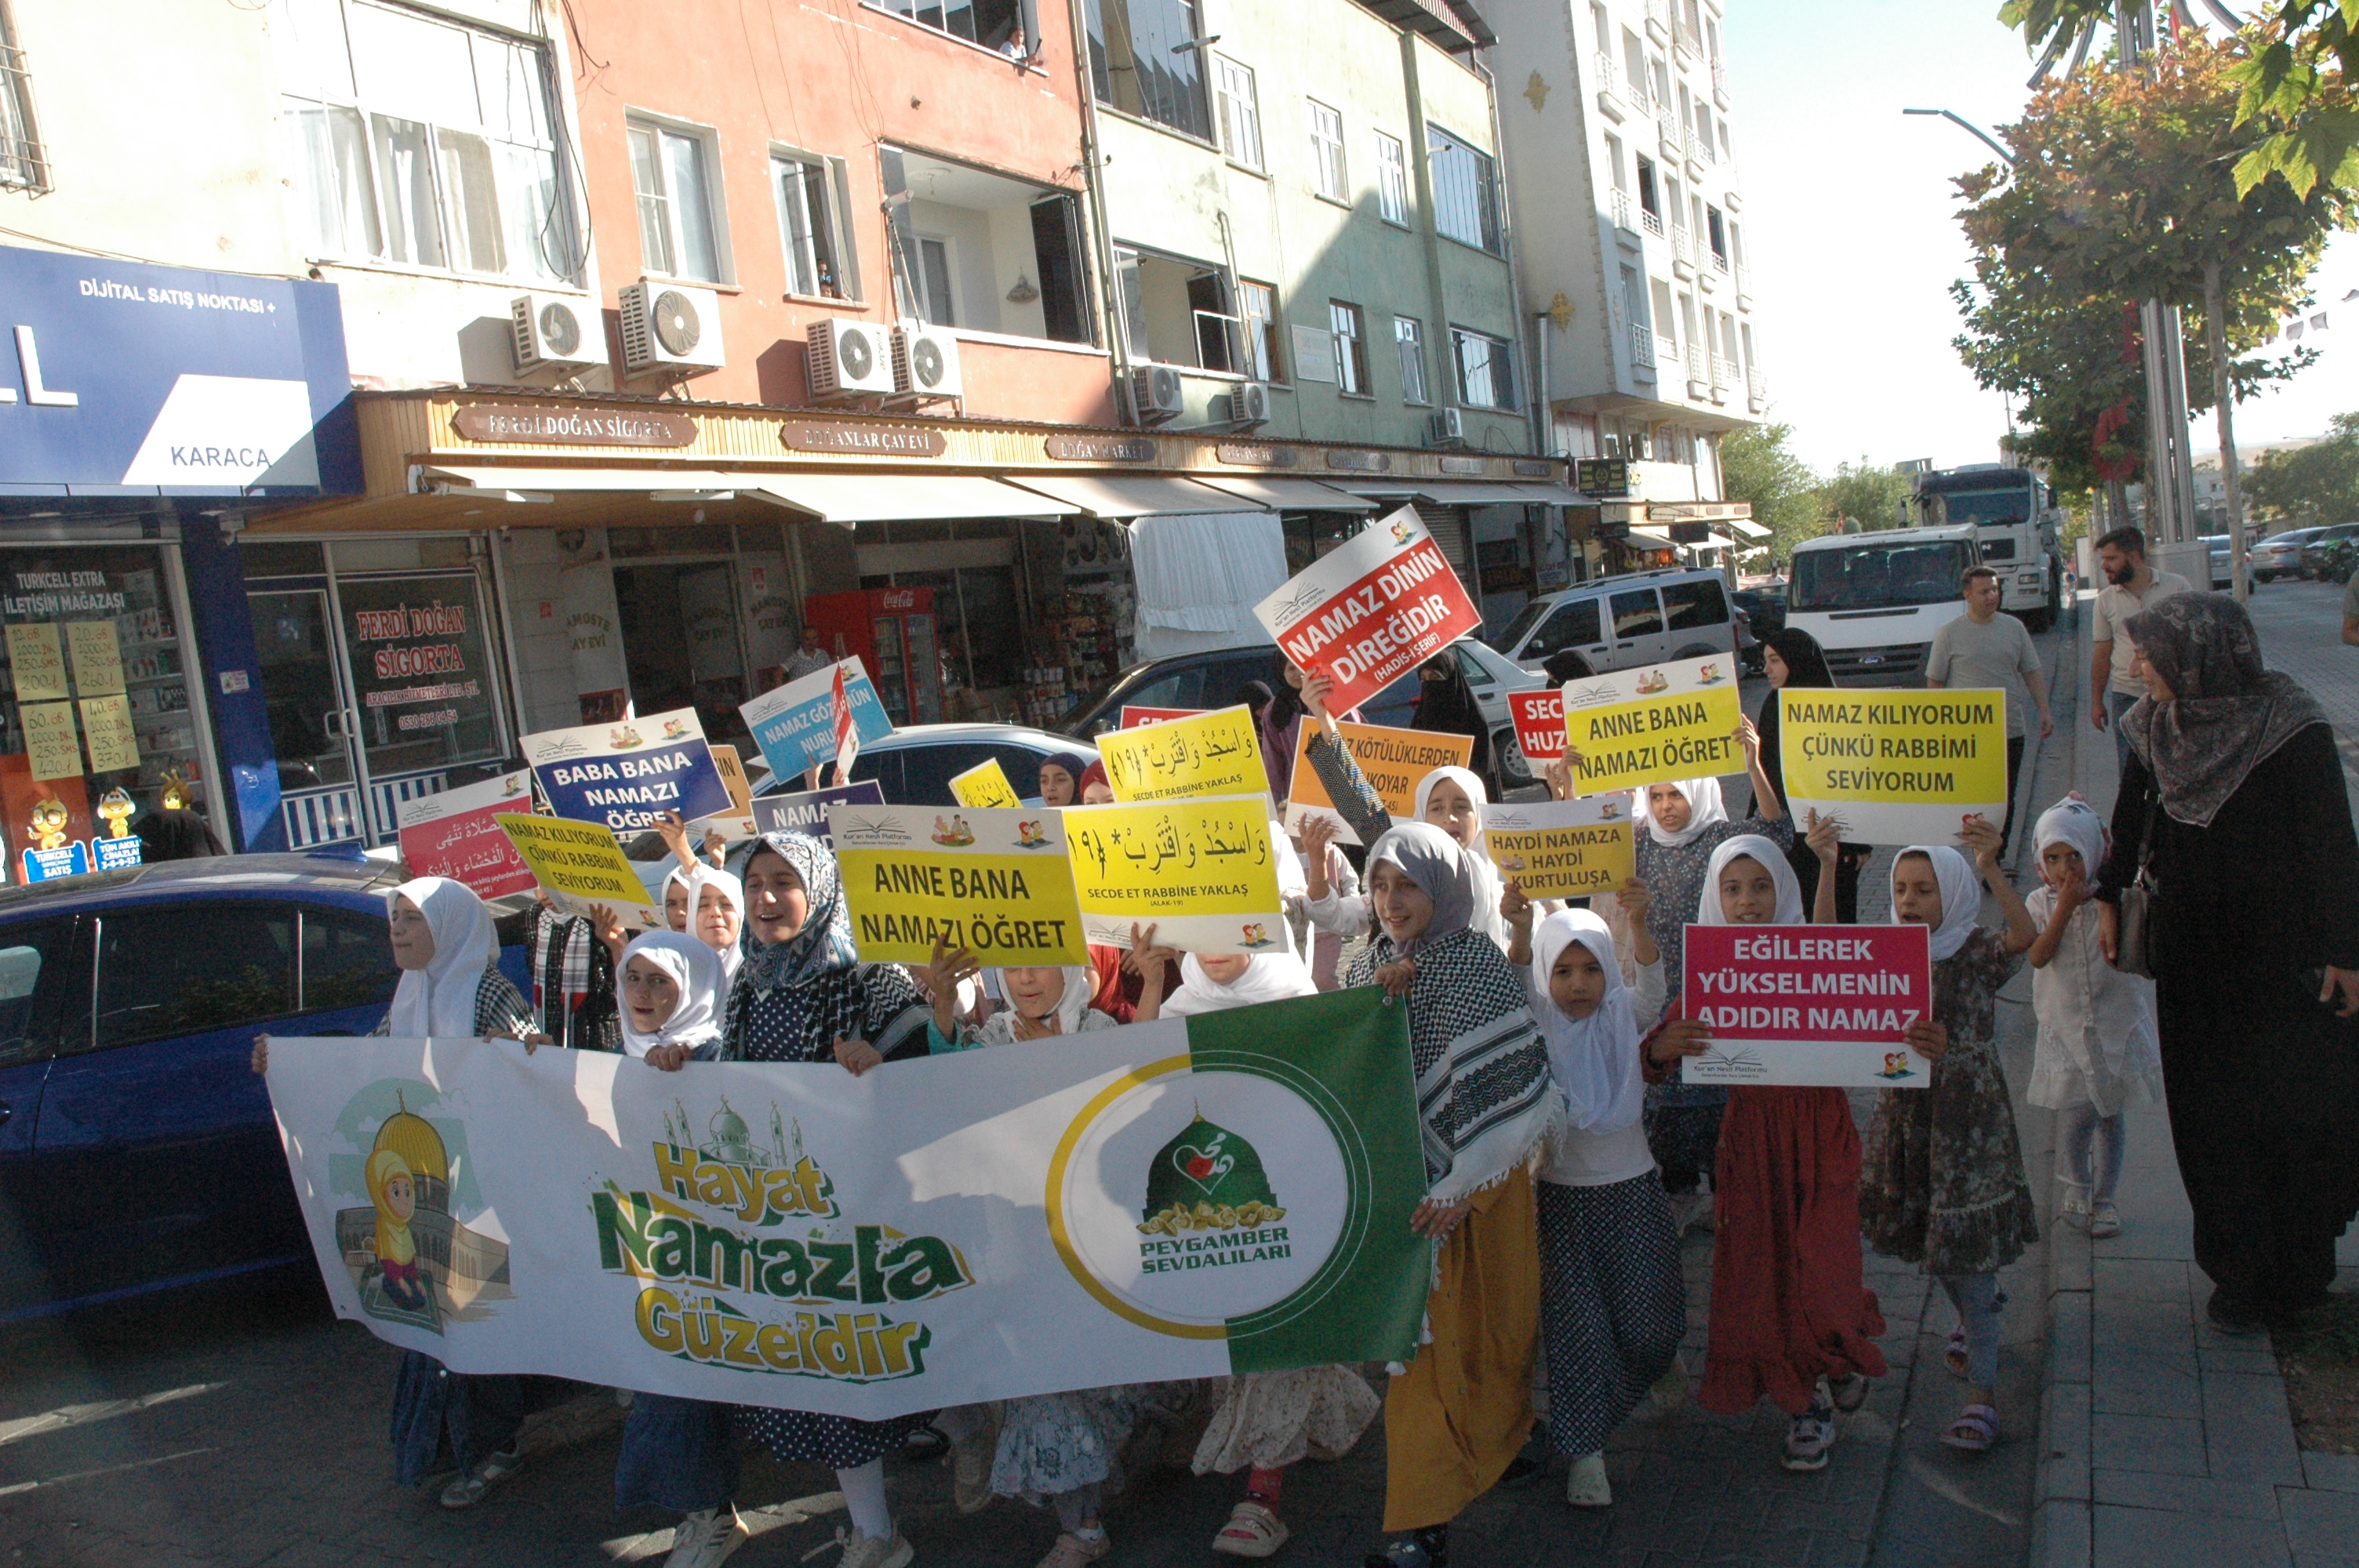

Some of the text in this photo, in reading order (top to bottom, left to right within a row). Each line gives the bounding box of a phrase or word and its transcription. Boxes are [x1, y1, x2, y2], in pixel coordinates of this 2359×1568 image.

[79, 278, 144, 302] DİJİTAL
[148, 288, 194, 309] SATIŞ
[198, 292, 264, 314] NOKTASI
[489, 412, 673, 438] FERDİ DOĞAN SİGORTA
[806, 427, 929, 451] DOĞANLAR ÇAY EVİ
[170, 446, 272, 468] KARACA
[1103, 445, 1143, 458] MARKET
[16, 571, 106, 589] TURKCELL EXTRA
[4, 591, 125, 615] İLETİŞİM MAĞAZASI
[1287, 585, 1384, 663] NAMAZ
[1377, 547, 1444, 601] DİNİN
[357, 600, 466, 641] FERDİ DOĞAN
[1331, 593, 1451, 684] DİREĞİDİR
[376, 643, 465, 679] SİGORTA
[1374, 632, 1441, 683] (HADİS-İ ŞERİF)
[399, 715, 419, 730] 0530
[765, 714, 811, 745] NAMAZ
[810, 688, 872, 726] GÖZMÜN
[1590, 702, 1708, 742] ANNE BANA
[1787, 703, 1994, 725] NAMAZ KILIYORUM
[1356, 736, 1460, 766] KÖTÜLÜKLERDEN
[1578, 735, 1732, 780] NAMAZI ÖĞRET
[1802, 732, 1976, 761] ÇÜNKÜ RABBİMİ
[553, 752, 692, 786] BABA BANA
[1826, 767, 1954, 792] SEVİYORUM
[584, 782, 679, 807] NAMAZI
[1133, 790, 1154, 801] SECDE
[1155, 789, 1163, 798] ET
[1165, 782, 1204, 797] RABBİNE
[1205, 773, 1242, 789] YAKLAŞ
[507, 822, 618, 850] NAMAZ KILIYORUM
[1492, 828, 1622, 851] HAYDİ NAMAZA
[528, 845, 623, 873] ÇÜNKÜ RABBİMİ
[1532, 848, 1583, 869] HAYDİ
[552, 871, 625, 894] SEVİYORUM
[875, 863, 1030, 899] ANNE BANA
[1088, 884, 1248, 898] SECDE ET RABBİNE YAKLAŞ
[1512, 869, 1612, 890] KURTULUŞA
[860, 913, 1065, 949] NAMAZI ÖĞRET
[1735, 934, 1874, 960] EĞİLEREK
[1698, 967, 1910, 996] YÜKSELMENİN
[1698, 1006, 1920, 1031] ADIDIR NAMAZ
[652, 1141, 841, 1226] Hayat
[591, 1189, 976, 1305] Namazla
[1140, 1227, 1289, 1257] PEYGAMBER
[1141, 1243, 1292, 1274] SEVDALILARI
[635, 1287, 932, 1385] Güzeldir
